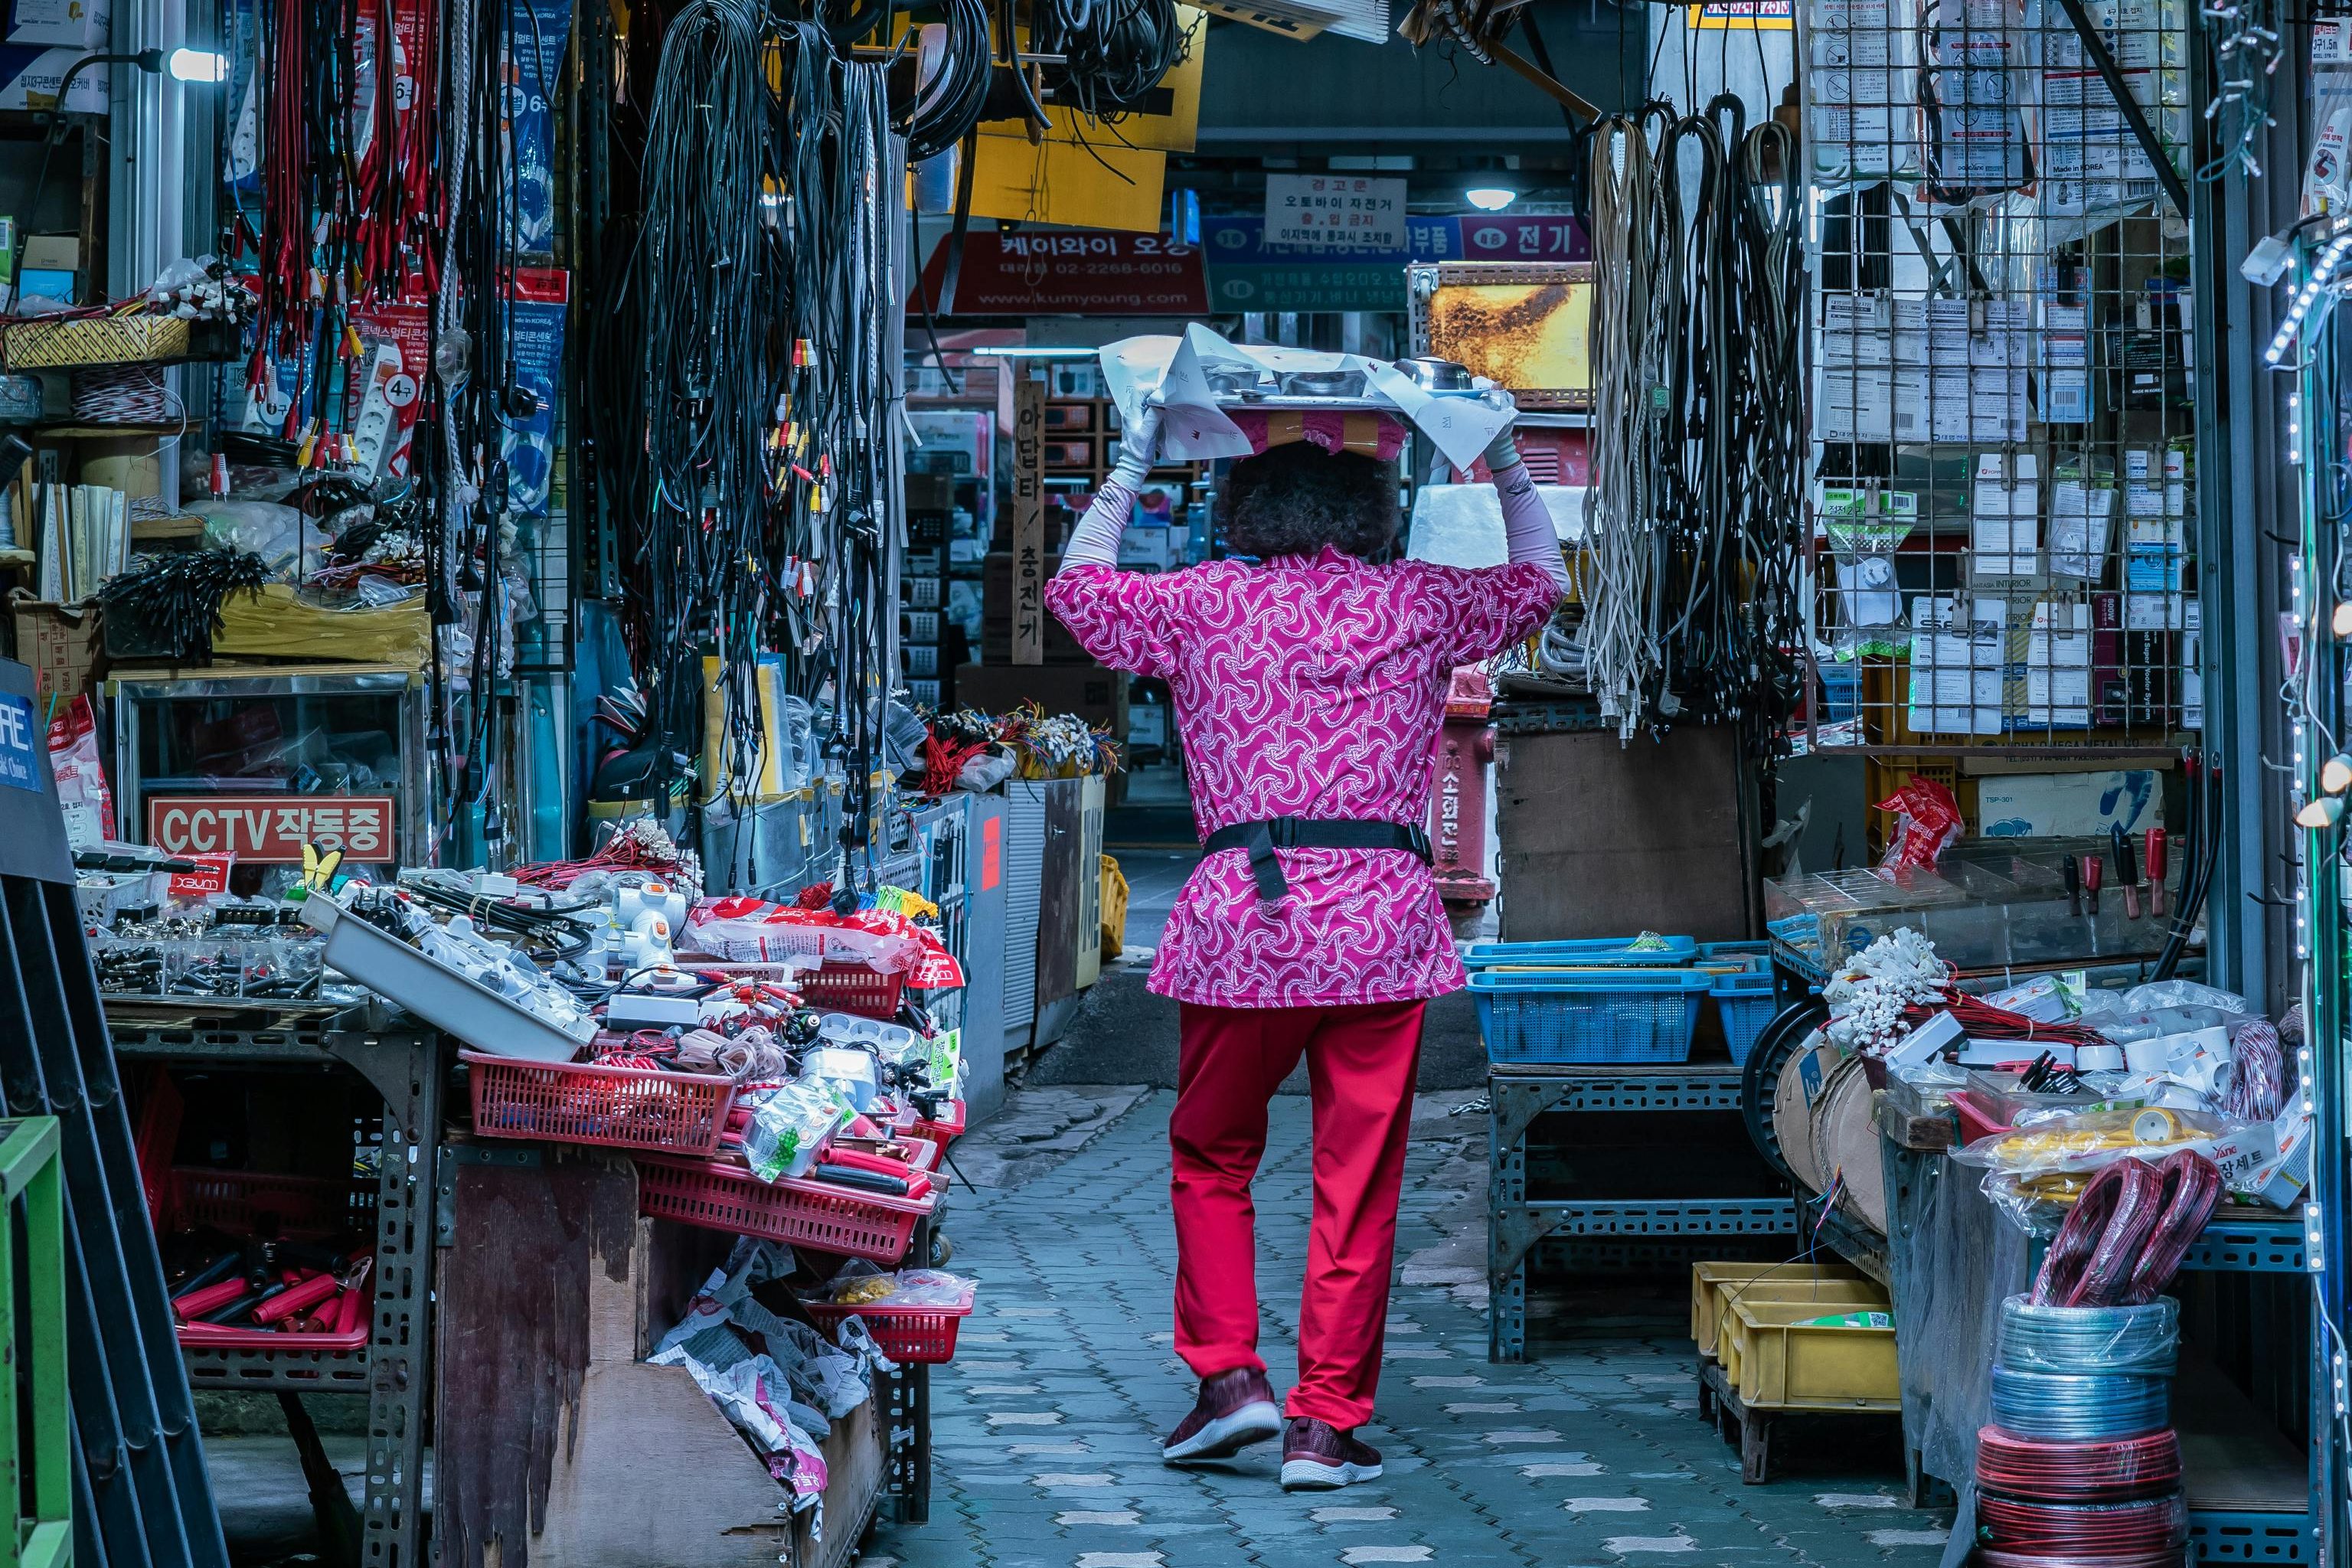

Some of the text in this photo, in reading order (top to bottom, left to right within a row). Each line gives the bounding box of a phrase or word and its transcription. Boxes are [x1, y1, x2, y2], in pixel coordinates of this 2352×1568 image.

[1285, 196, 1392, 211] 오토바이 자전거
[1001, 237, 1118, 256] 케이와이
[390, 381, 412, 397] 4구
[1019, 403, 1040, 501] 아답타
[1018, 545, 1039, 647] 충전기
